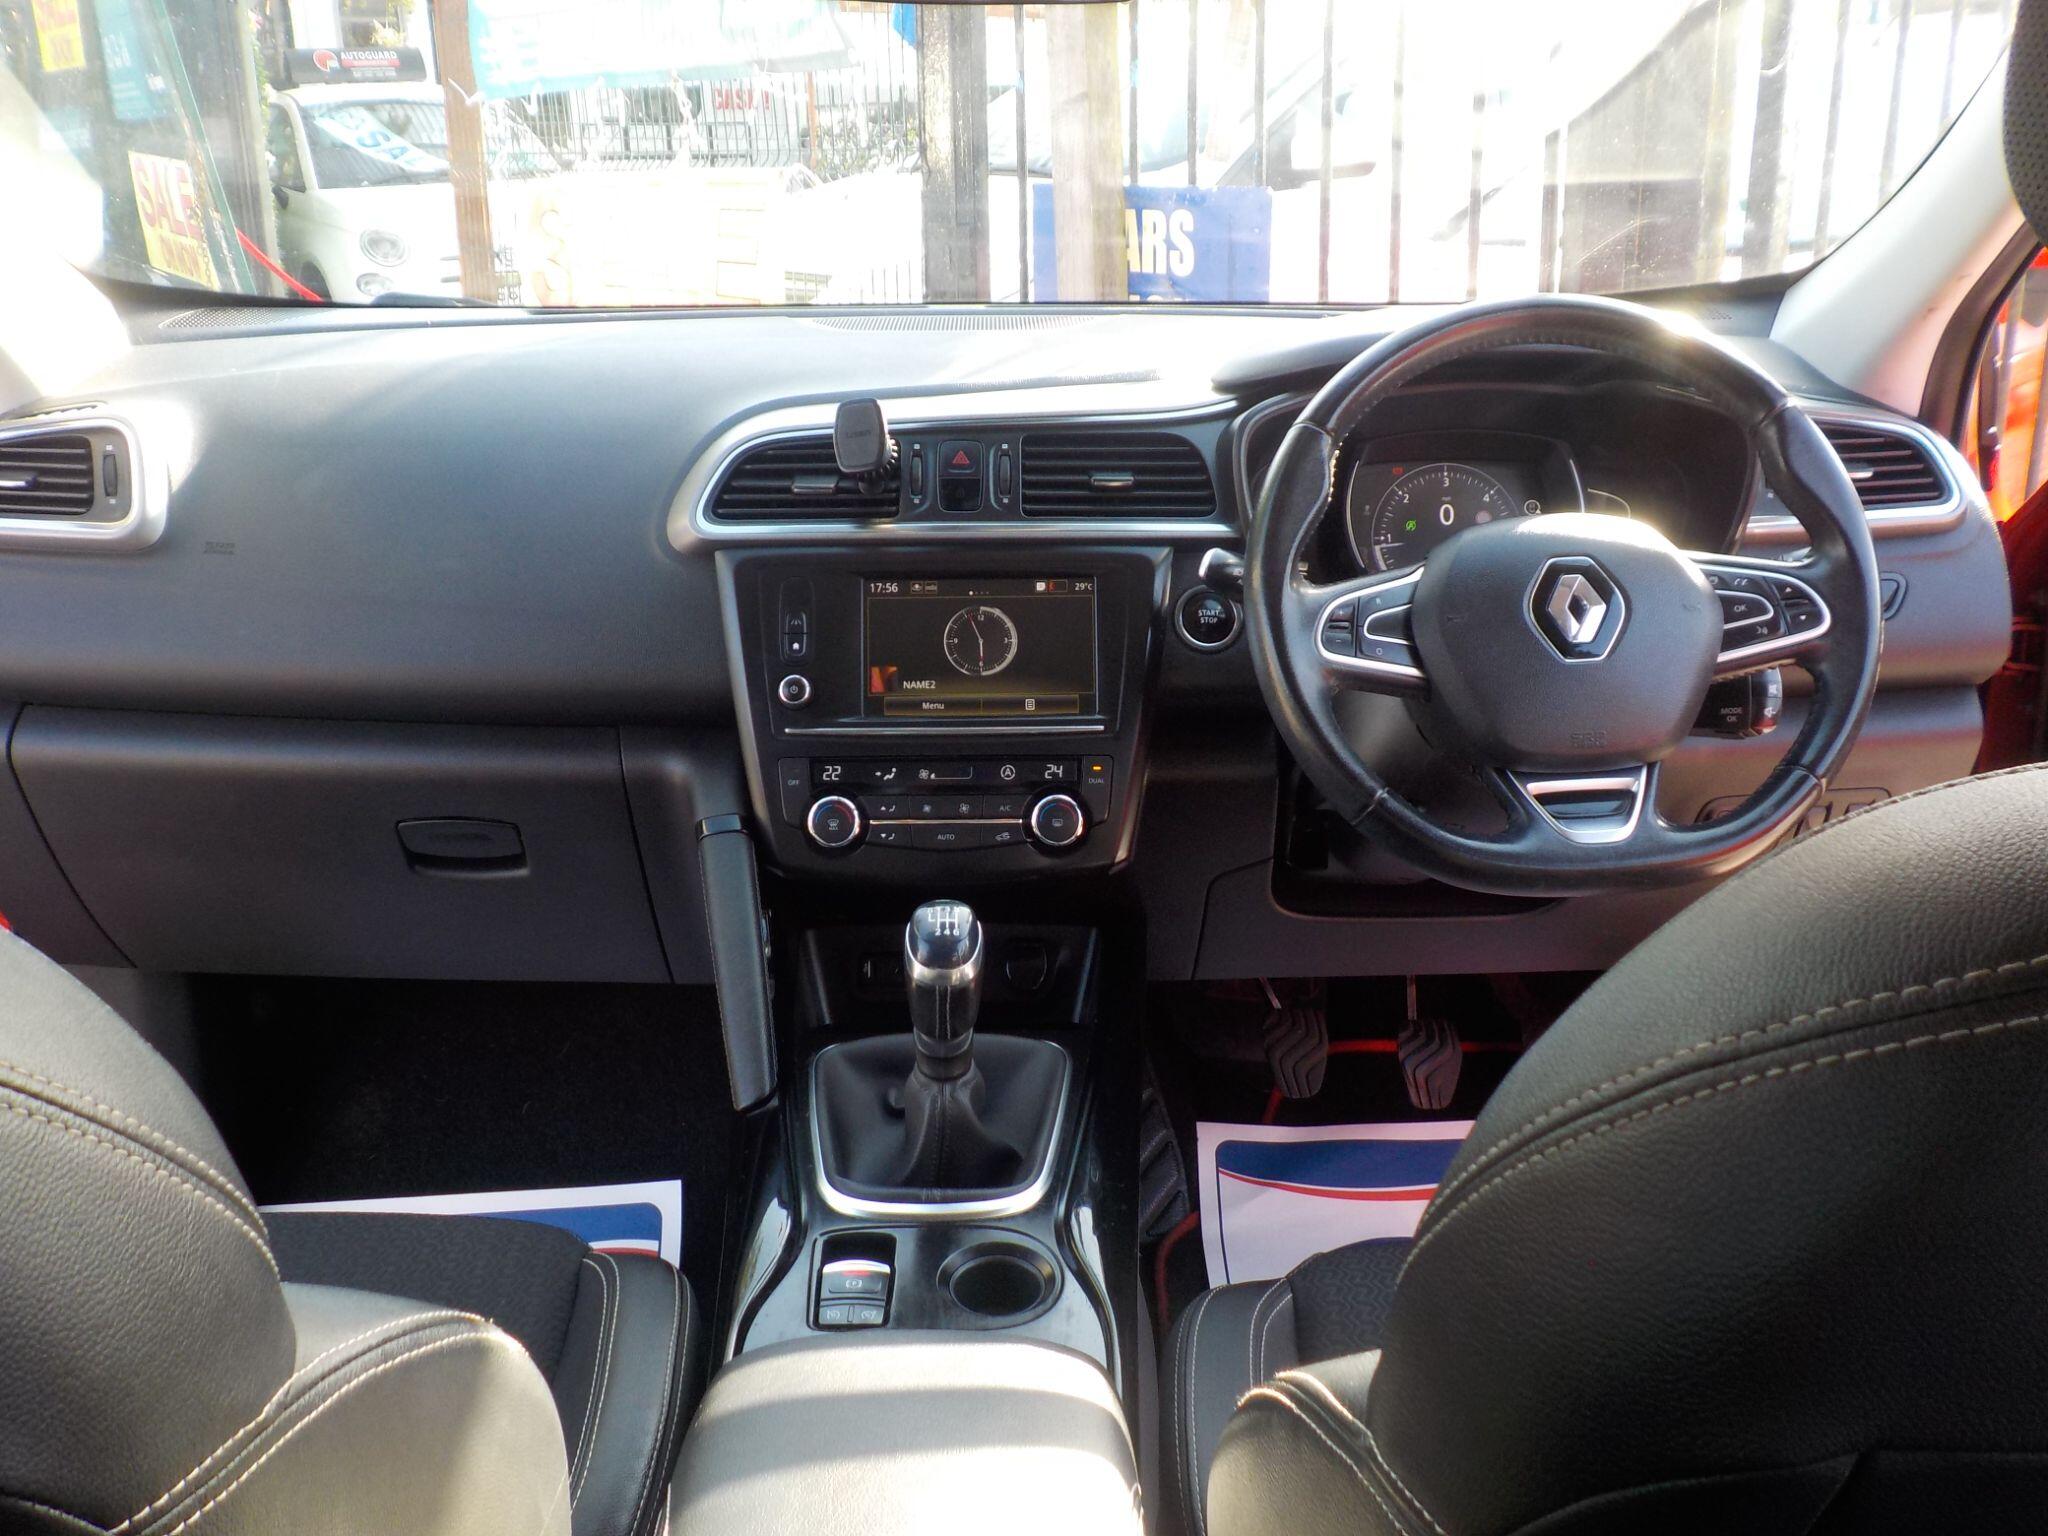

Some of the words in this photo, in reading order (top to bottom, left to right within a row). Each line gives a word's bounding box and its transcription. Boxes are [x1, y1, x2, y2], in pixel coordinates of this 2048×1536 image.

[341, 51, 397, 60] AUTOGUARD
[1125, 208, 1194, 277] ARS
[1443, 478, 1450, 487] 3
[1403, 494, 1410, 503] 2
[1483, 494, 1490, 502] 4
[1439, 504, 1454, 526] 0
[870, 583, 899, 593] 17:56
[1734, 604, 1747, 612] OK
[1198, 609, 1219, 617] START
[1200, 616, 1218, 624] STOP
[903, 681, 936, 689] NAME2
[922, 702, 944, 710] Menu
[822, 766, 841, 780] 22
[1044, 764, 1064, 779] 24
